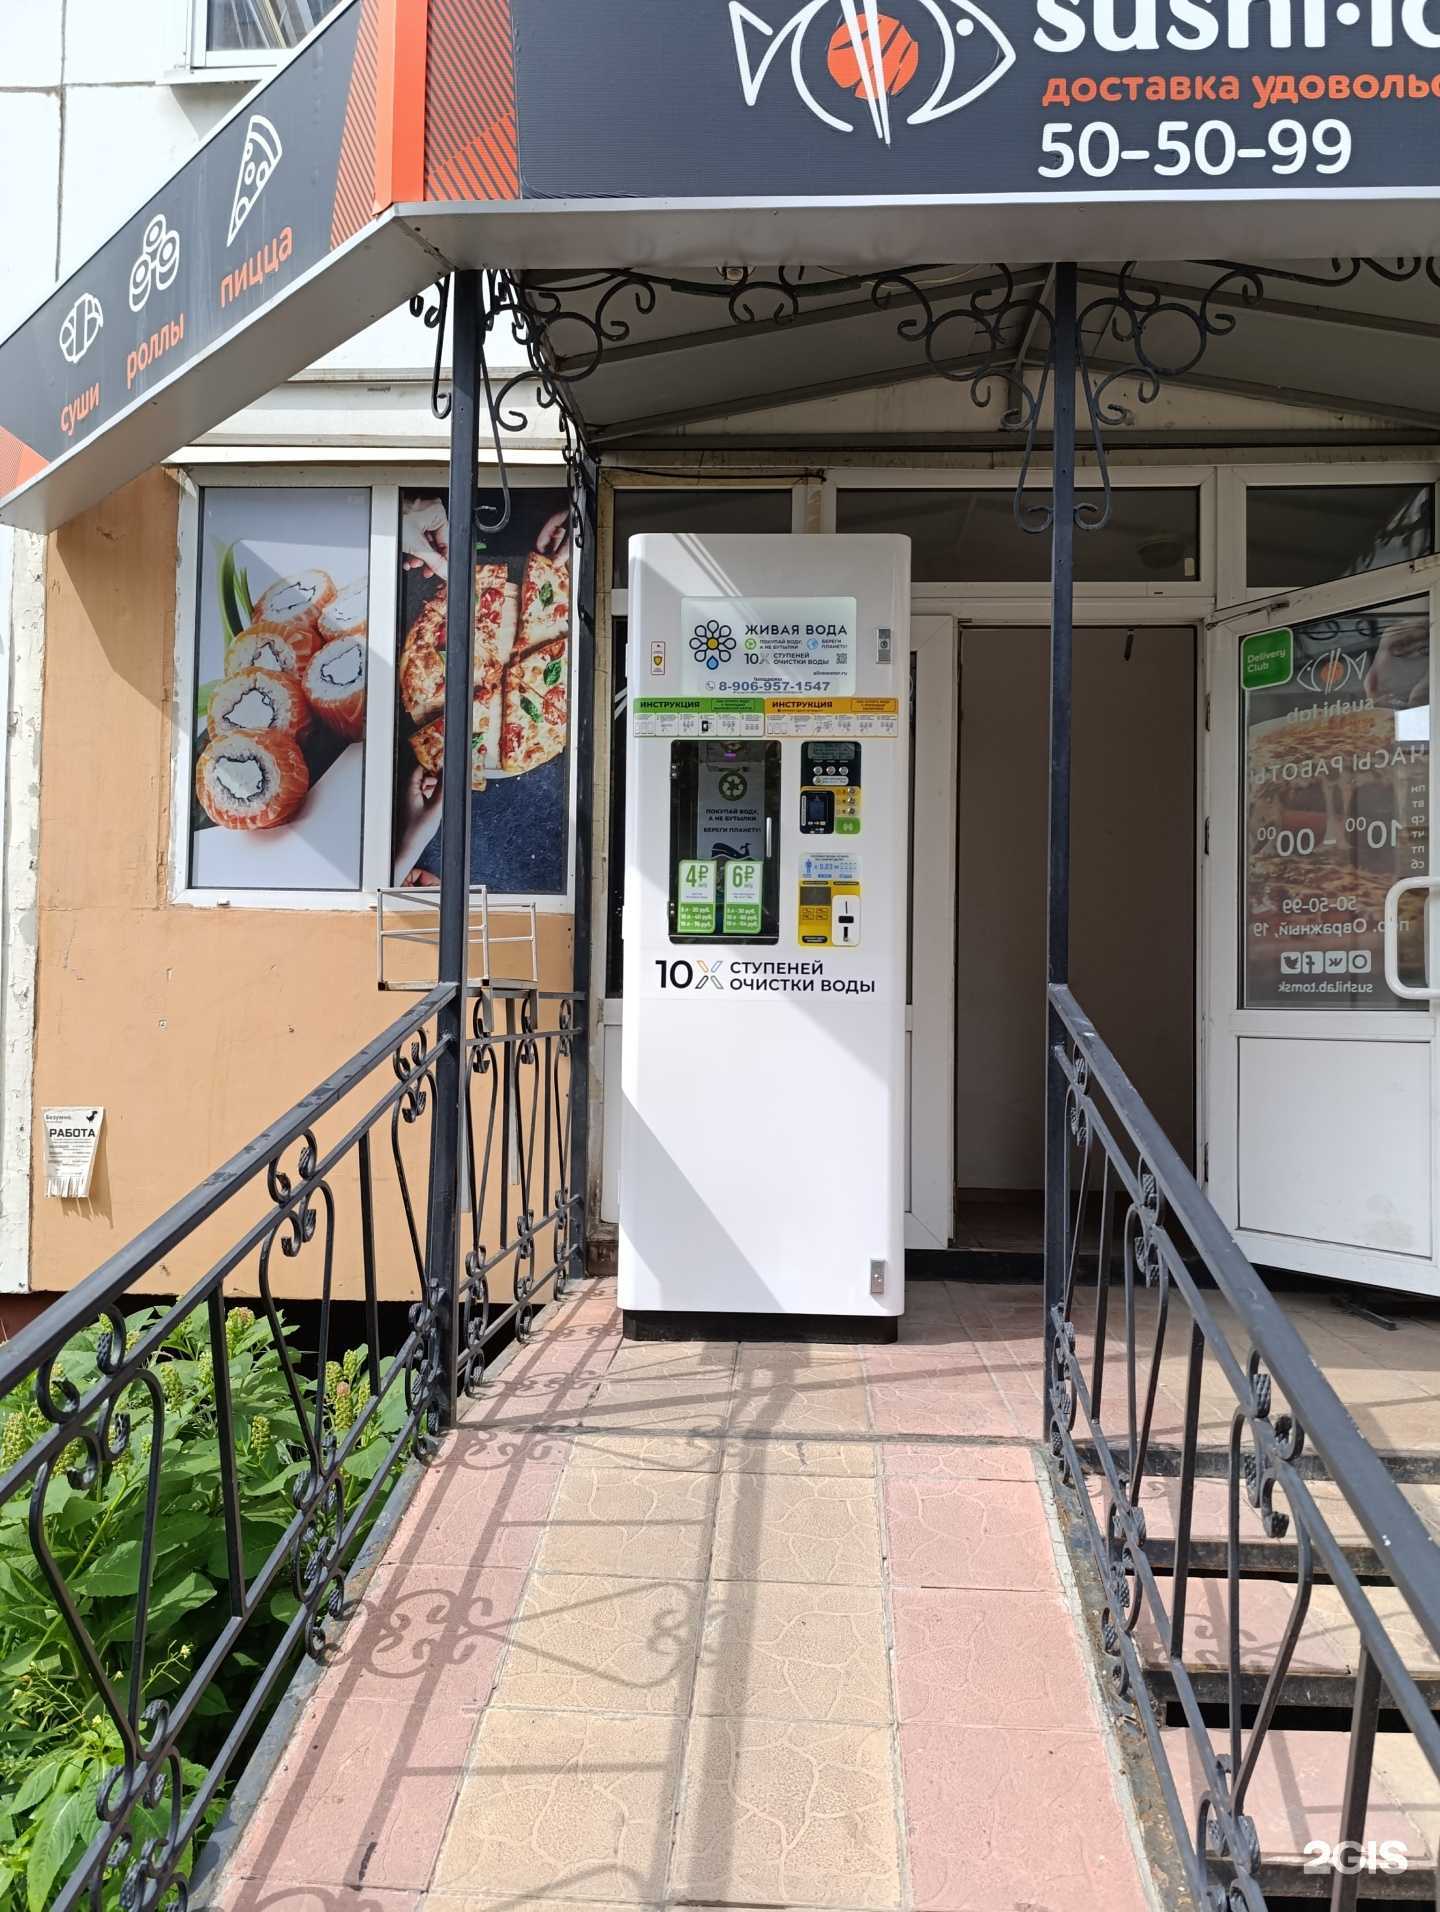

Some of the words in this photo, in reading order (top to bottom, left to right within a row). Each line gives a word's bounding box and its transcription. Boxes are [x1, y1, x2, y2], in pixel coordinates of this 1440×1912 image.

[1041, 74, 1240, 107] доставка
[1038, 119, 1352, 178] 50-50-99
[220, 225, 293, 308] пицца
[127, 312, 185, 389] роллы
[60, 381, 101, 436] суши
[744, 624, 800, 635] ЖИВАЯ
[805, 624, 848, 636] ВОДА
[1247, 648, 1286, 663] Delivery
[1247, 662, 1270, 673] Club
[719, 681, 831, 692] 8-906-957-1547
[640, 701, 700, 709] ИНСТРУКЦИЯ
[772, 701, 833, 709] ИНСТРУКЦИЯ
[730, 959, 824, 975] СТУПЕНЕЙ
[730, 978, 815, 992] ОЧИСТКИ
[820, 979, 875, 994] ВОДЫ
[49, 1128, 96, 1138] РАБОТА
